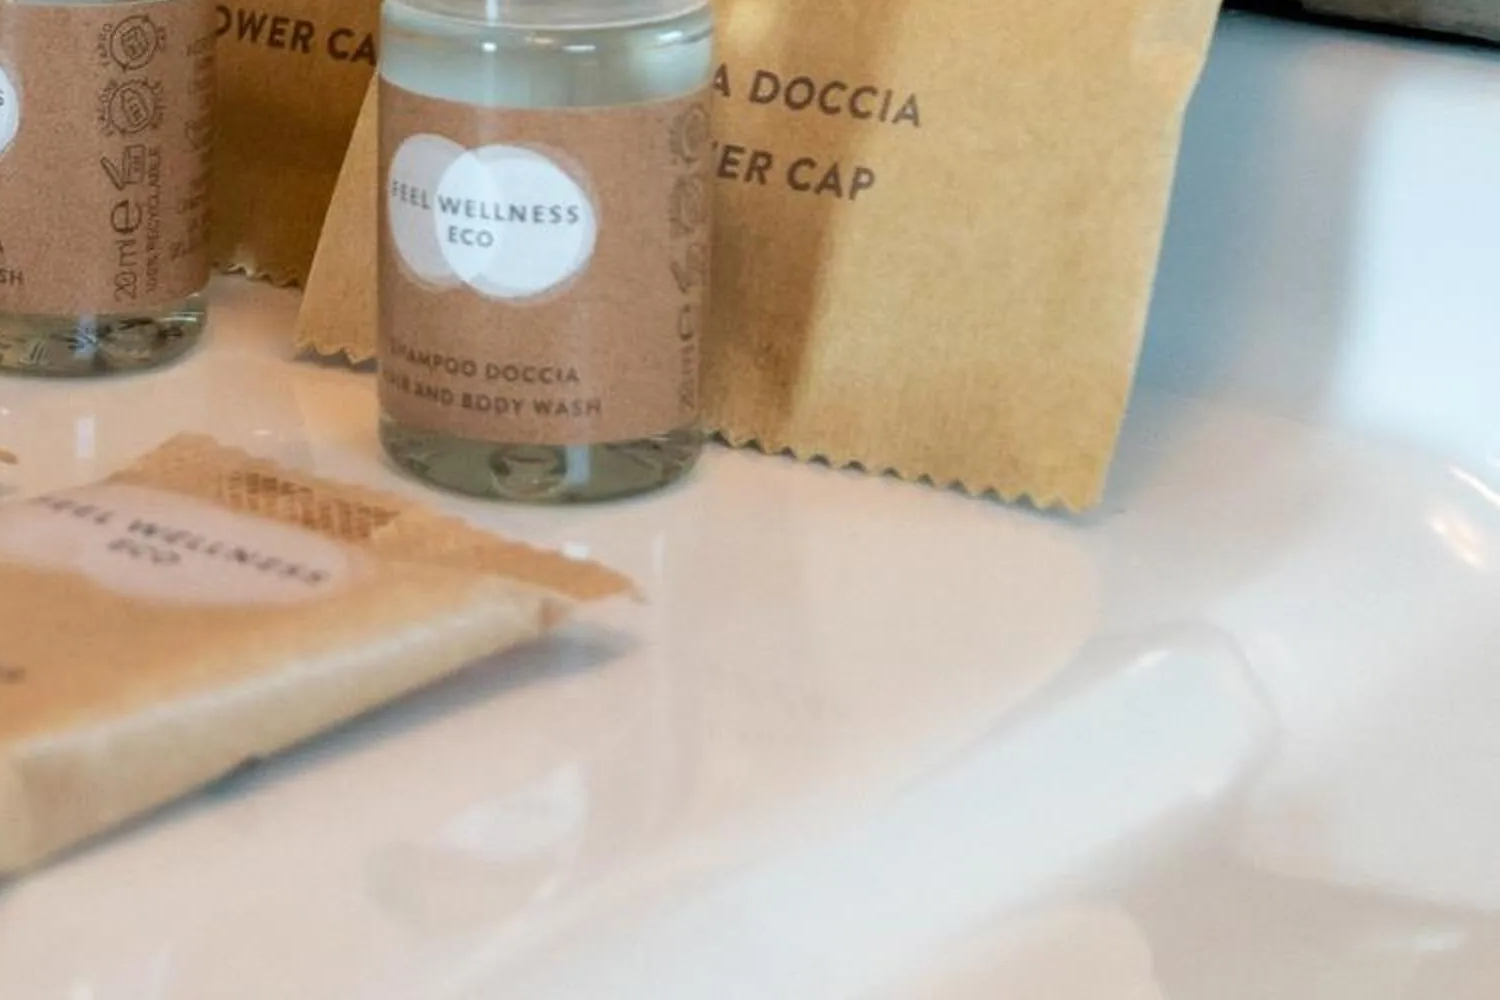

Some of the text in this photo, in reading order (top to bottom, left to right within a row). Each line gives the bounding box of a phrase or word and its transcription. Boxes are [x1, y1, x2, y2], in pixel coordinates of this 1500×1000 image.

[214, 3, 316, 55] OWER
[326, 26, 379, 68] CA
[747, 68, 921, 127] DOCCIA
[786, 156, 876, 201] CAP
[437, 194, 581, 225] WELLNESS
[446, 225, 495, 249] ECO
[484, 363, 581, 385] DOCCIA
[461, 392, 522, 416] BODY
[533, 398, 601, 418] WASH
